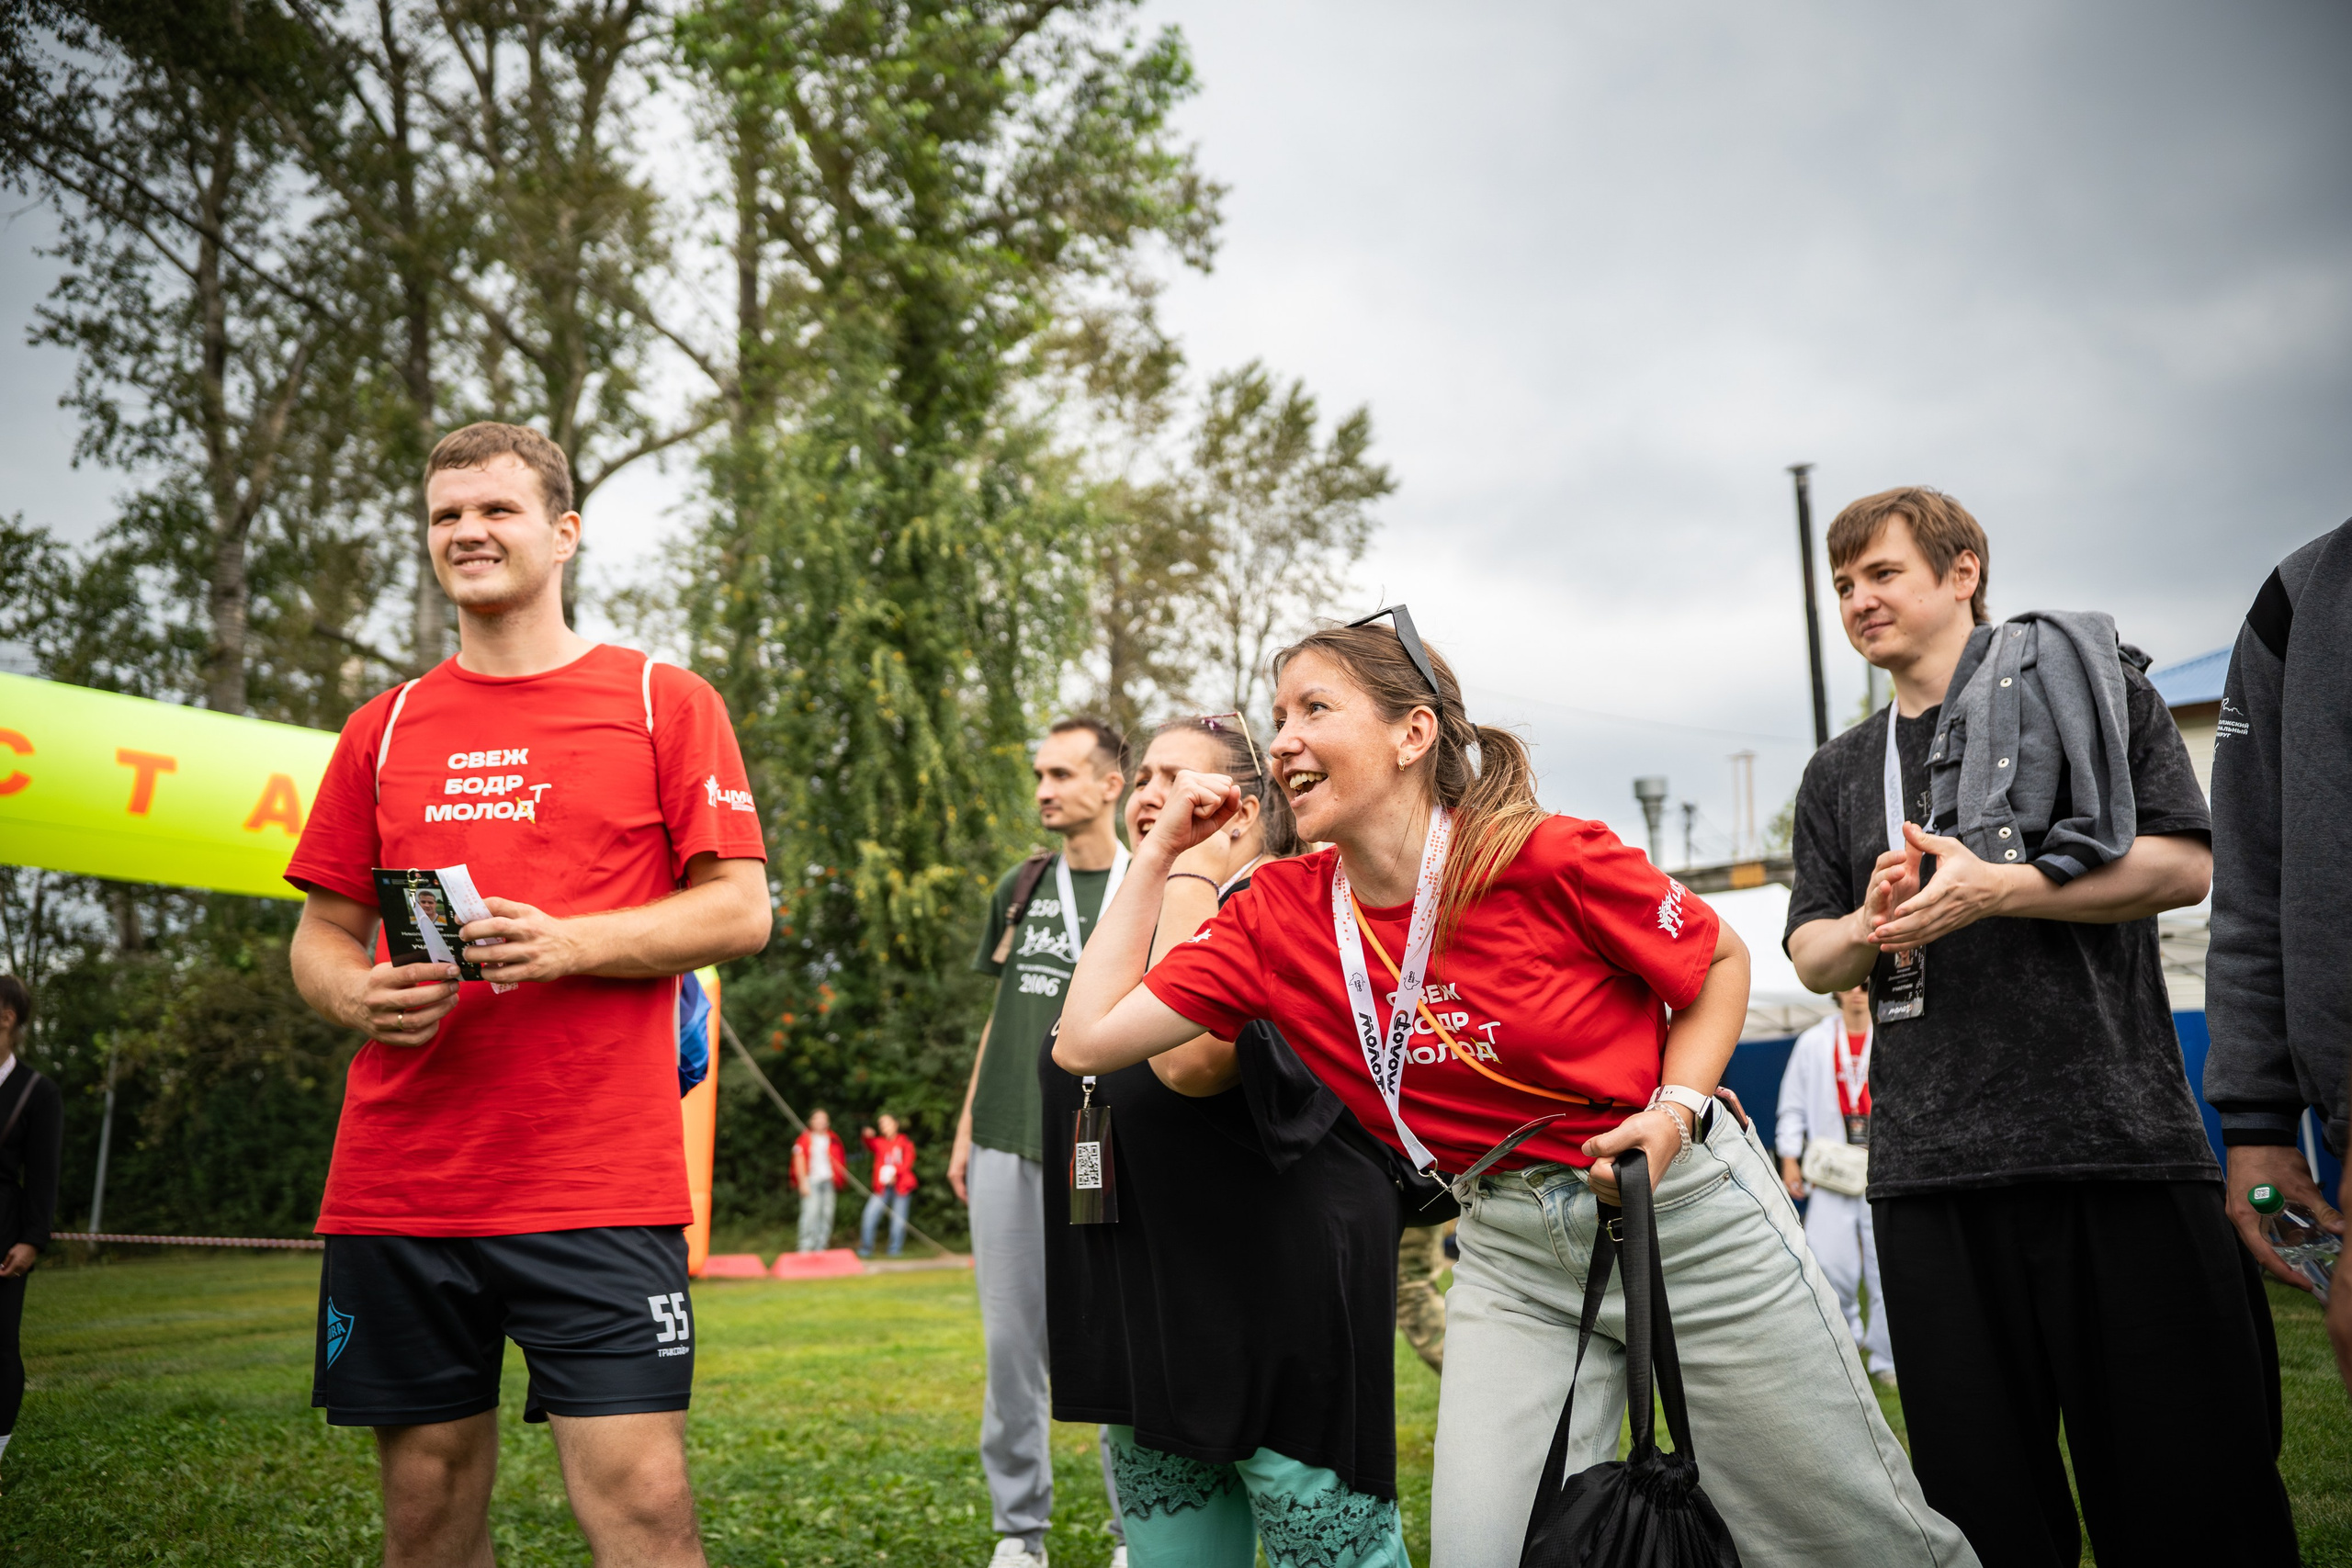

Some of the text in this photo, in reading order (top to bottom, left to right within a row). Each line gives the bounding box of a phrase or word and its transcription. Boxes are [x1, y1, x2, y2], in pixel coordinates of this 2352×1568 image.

[447, 748, 529, 770] СВЕЖ
[444, 774, 525, 796] БОДР
[424, 798, 536, 823] МОЛОД
[1409, 1011, 1470, 1036] ОДР
[647, 1292, 689, 1343] 55
